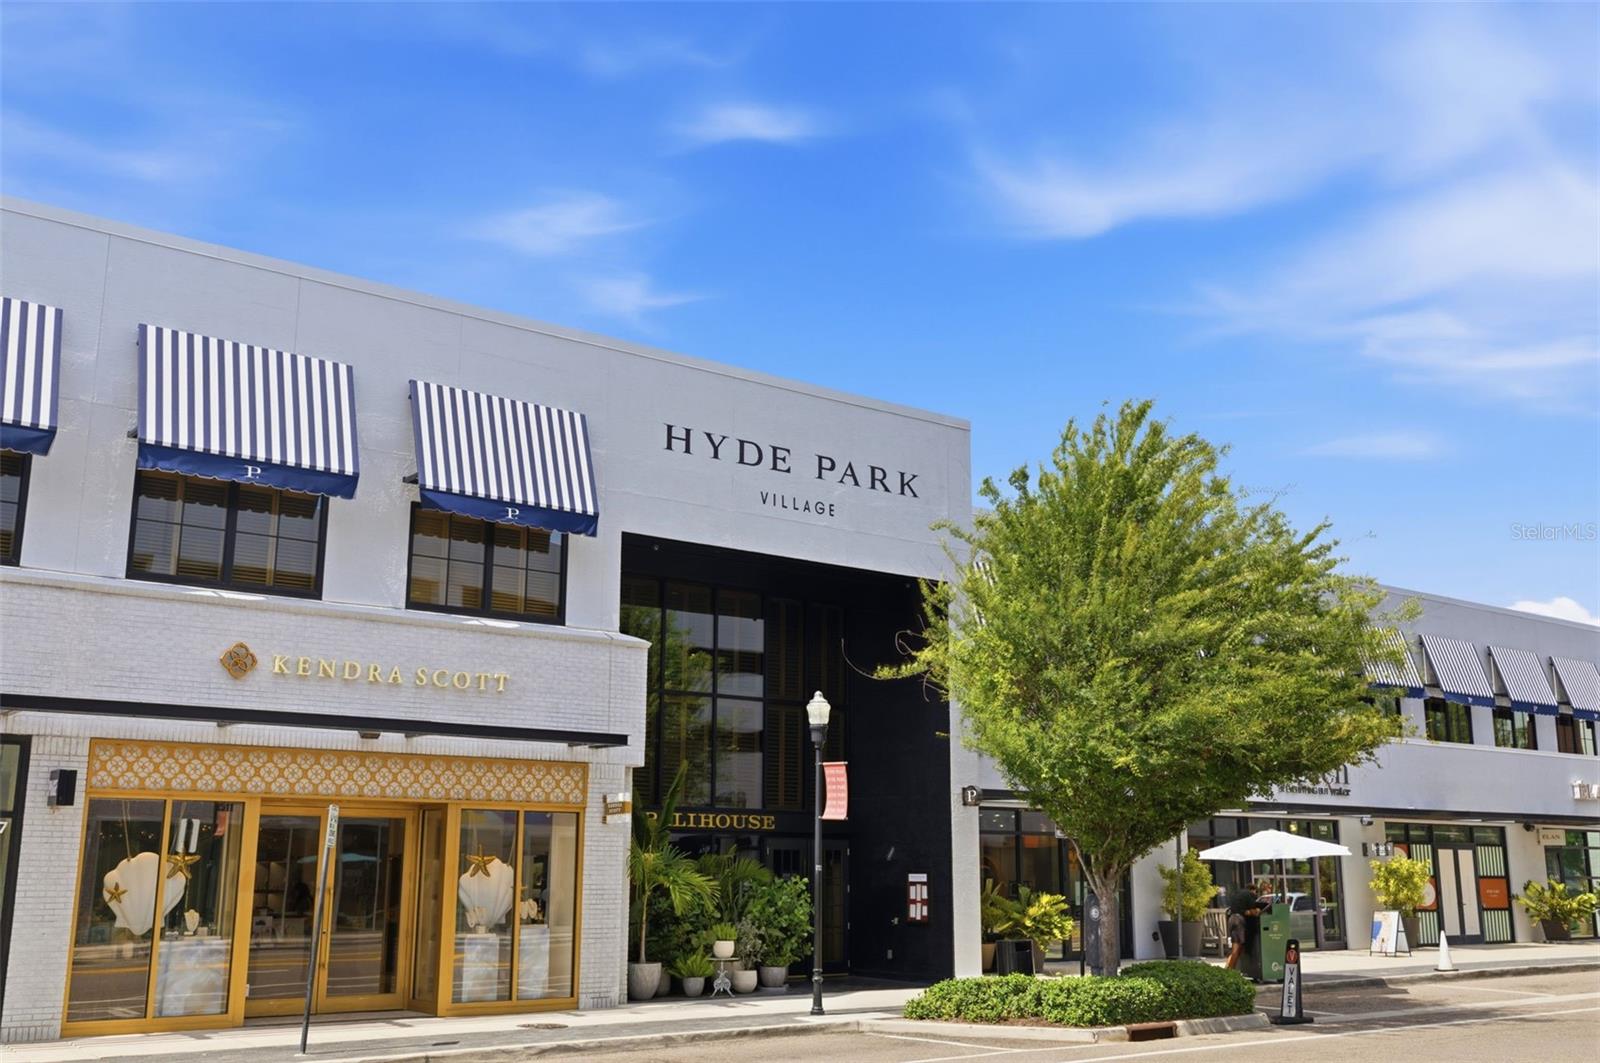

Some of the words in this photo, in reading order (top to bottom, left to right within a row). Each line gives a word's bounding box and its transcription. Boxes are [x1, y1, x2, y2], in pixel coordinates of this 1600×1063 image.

[663, 422, 792, 474] HYDE
[814, 453, 920, 499] PARK
[760, 490, 836, 517] VILLAGE
[272, 654, 404, 685] KENDRA
[415, 666, 511, 692] SCOTT
[646, 811, 776, 830] PLIHOUSE
[1287, 966, 1296, 1014] VALET
